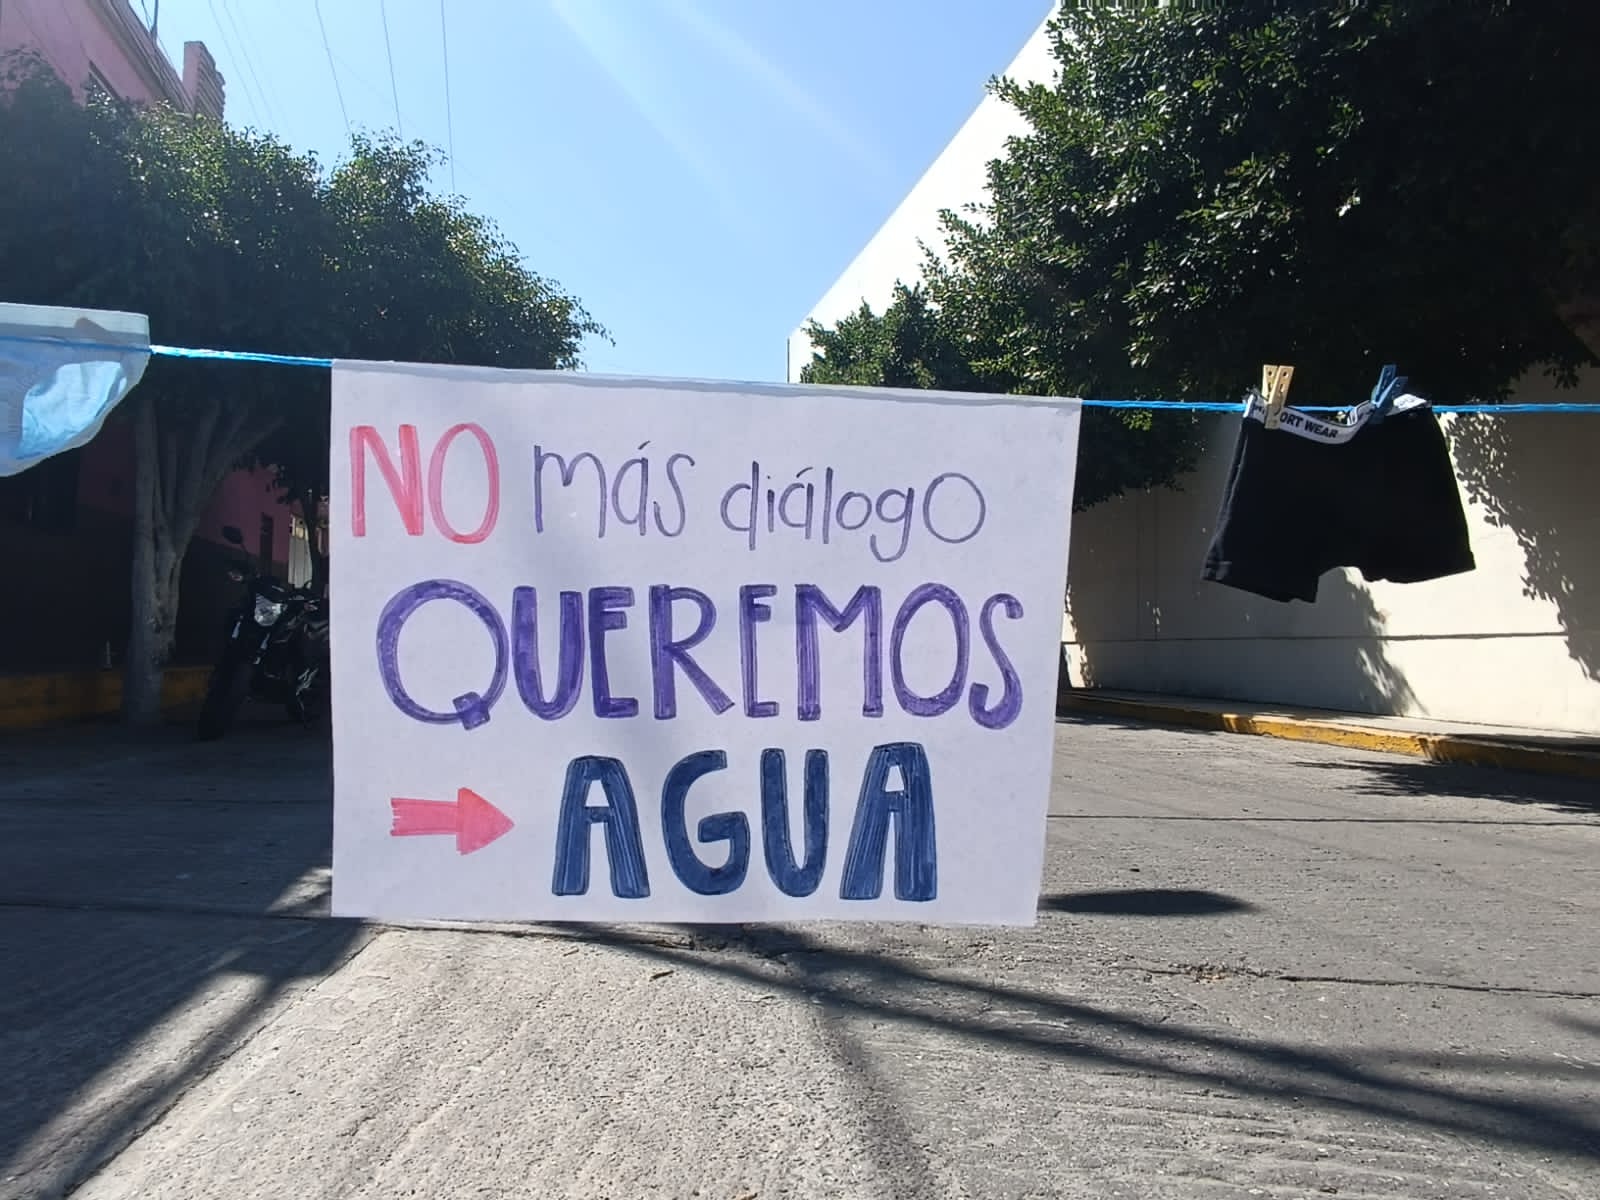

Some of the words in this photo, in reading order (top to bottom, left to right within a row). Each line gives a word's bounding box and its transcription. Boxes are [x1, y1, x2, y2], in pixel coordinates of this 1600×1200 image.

[349, 422, 500, 544] NO
[534, 440, 695, 538] más
[1280, 411, 1304, 428] ORT
[1304, 419, 1338, 438] WEAR
[376, 579, 1024, 731] QUEREMOS
[551, 742, 938, 903] AGUA
